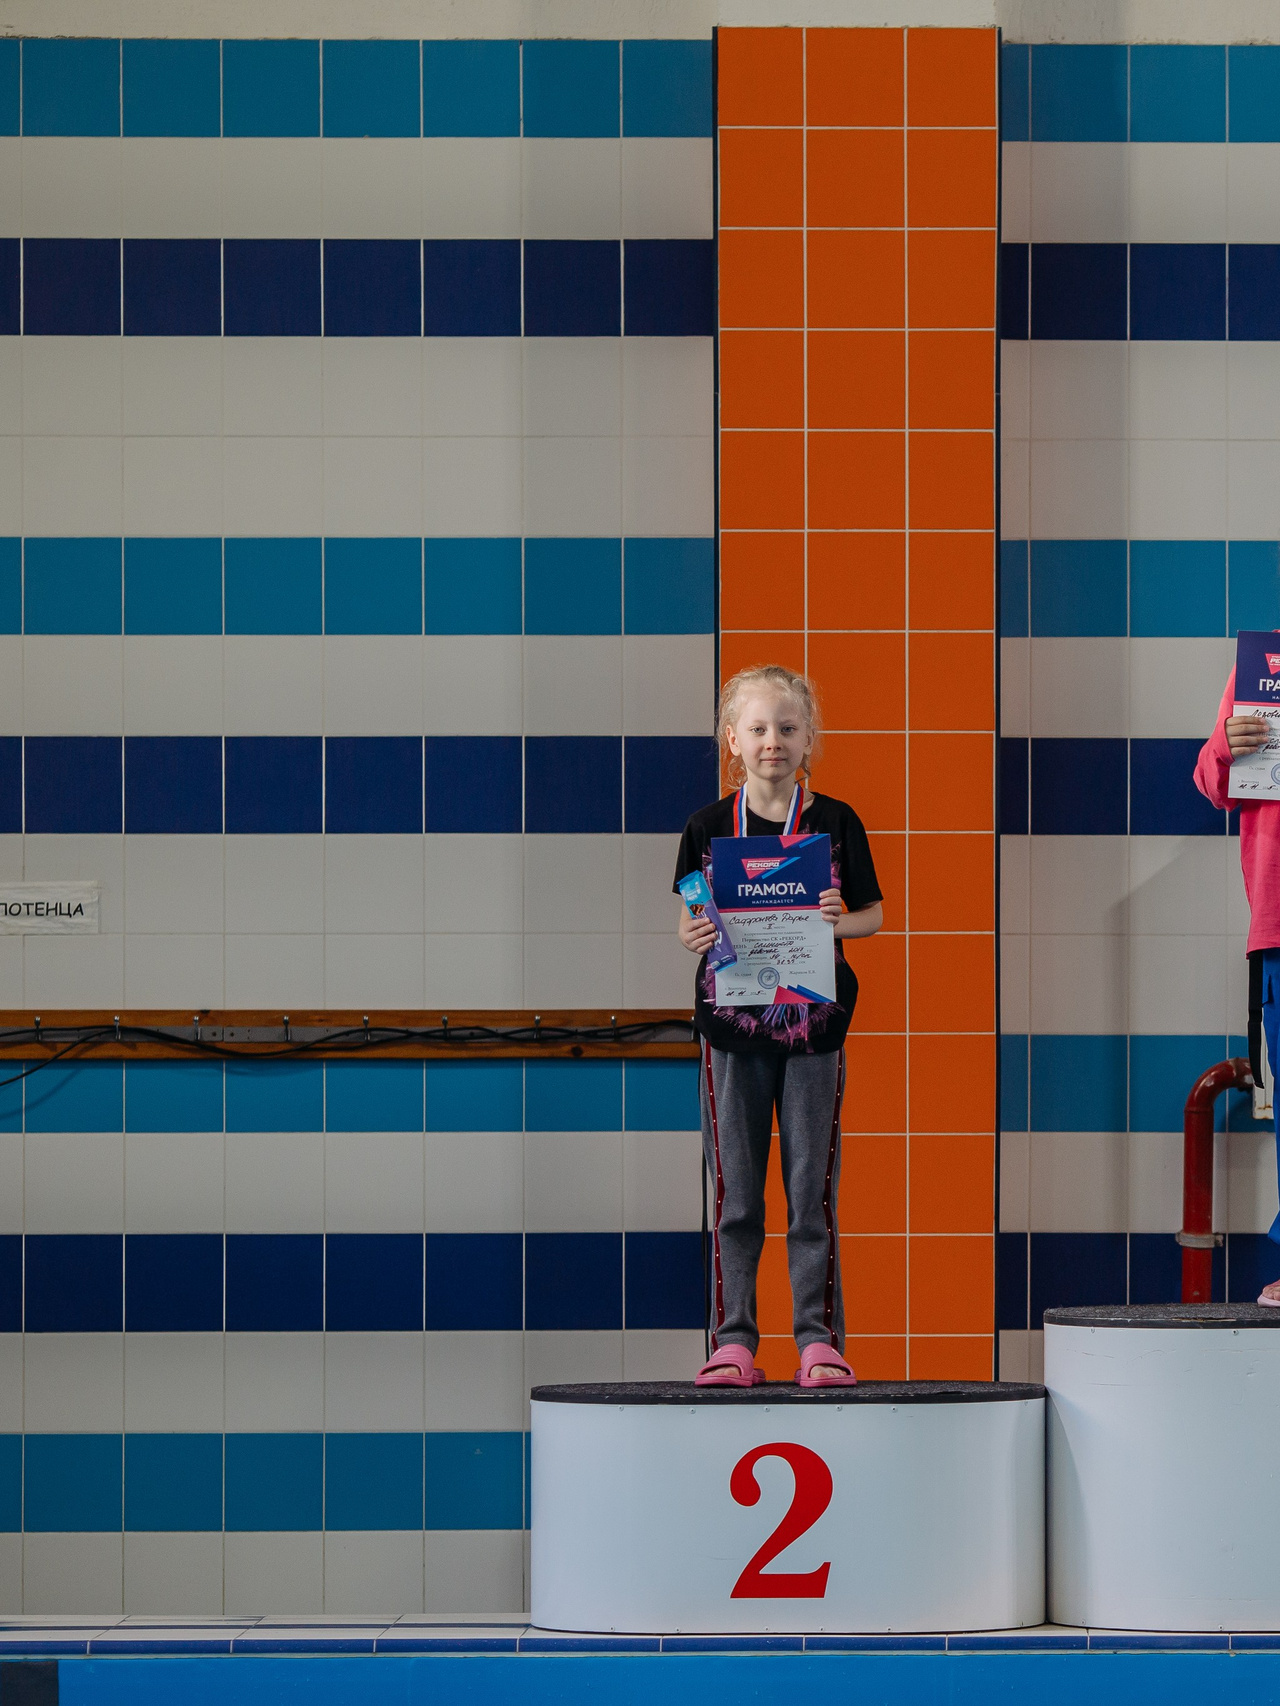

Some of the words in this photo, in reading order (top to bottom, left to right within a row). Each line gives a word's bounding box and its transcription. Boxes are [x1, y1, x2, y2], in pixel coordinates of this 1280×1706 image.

[747, 861, 780, 869] РЕКОРД
[738, 882, 807, 897] ГРАМОТА
[730, 1442, 833, 1598] 2
